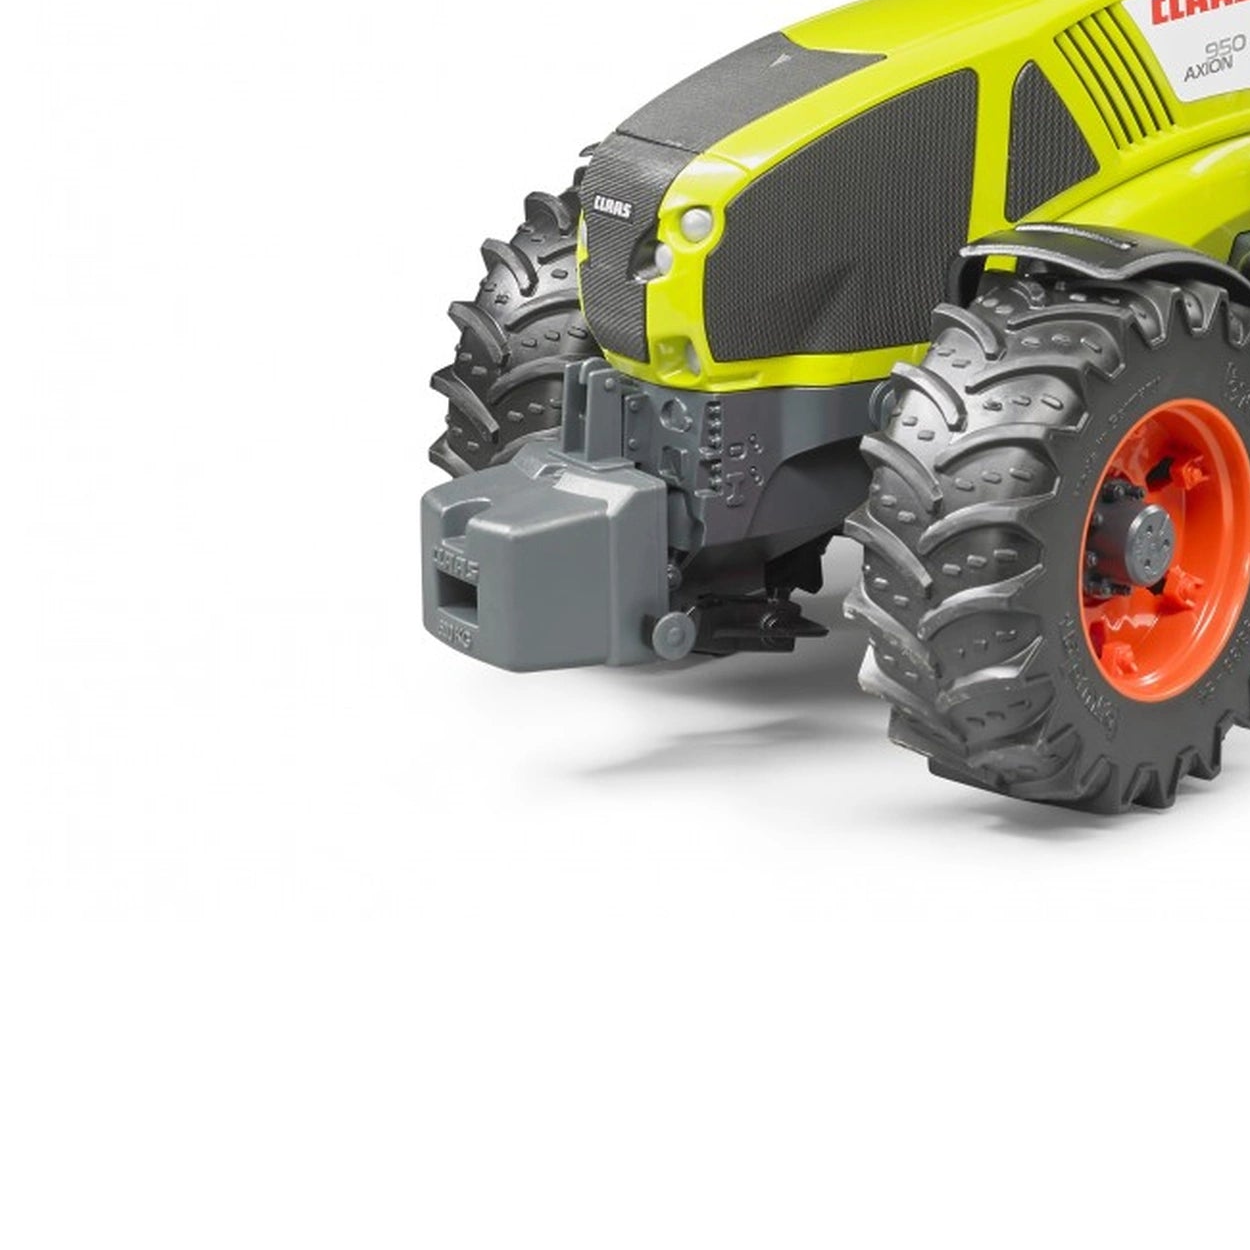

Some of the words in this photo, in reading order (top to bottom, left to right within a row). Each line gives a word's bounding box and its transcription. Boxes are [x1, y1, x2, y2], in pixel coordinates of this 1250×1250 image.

[1205, 34, 1247, 60] 950
[1184, 55, 1233, 82] AXION
[593, 195, 632, 219] CLAAS
